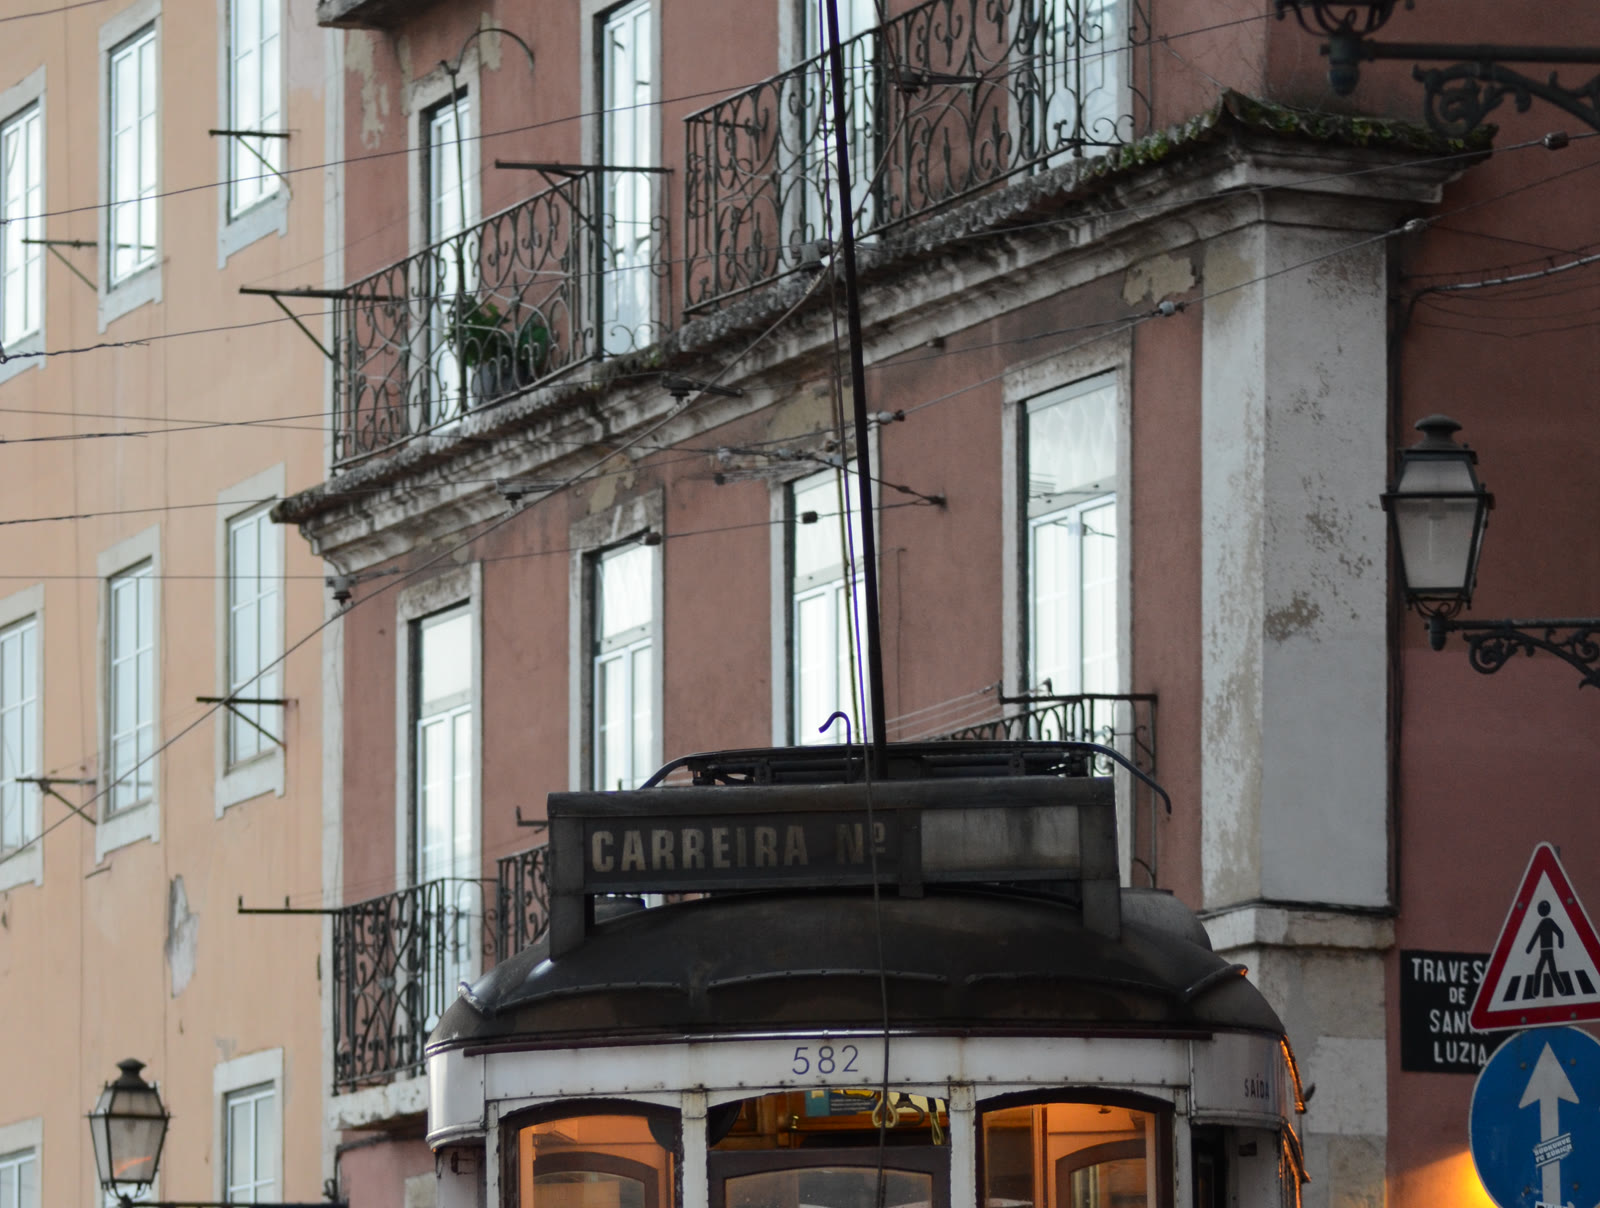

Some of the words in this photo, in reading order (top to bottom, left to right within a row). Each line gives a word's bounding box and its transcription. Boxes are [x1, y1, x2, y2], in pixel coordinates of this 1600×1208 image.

[591, 825, 809, 872] CARREIRA
[1411, 958, 1490, 984] TRAVES
[1449, 986, 1466, 1004] DE
[792, 1044, 859, 1075] 582
[1434, 1041, 1487, 1066] LUZIA
[1244, 1073, 1270, 1099] SAÍDA
